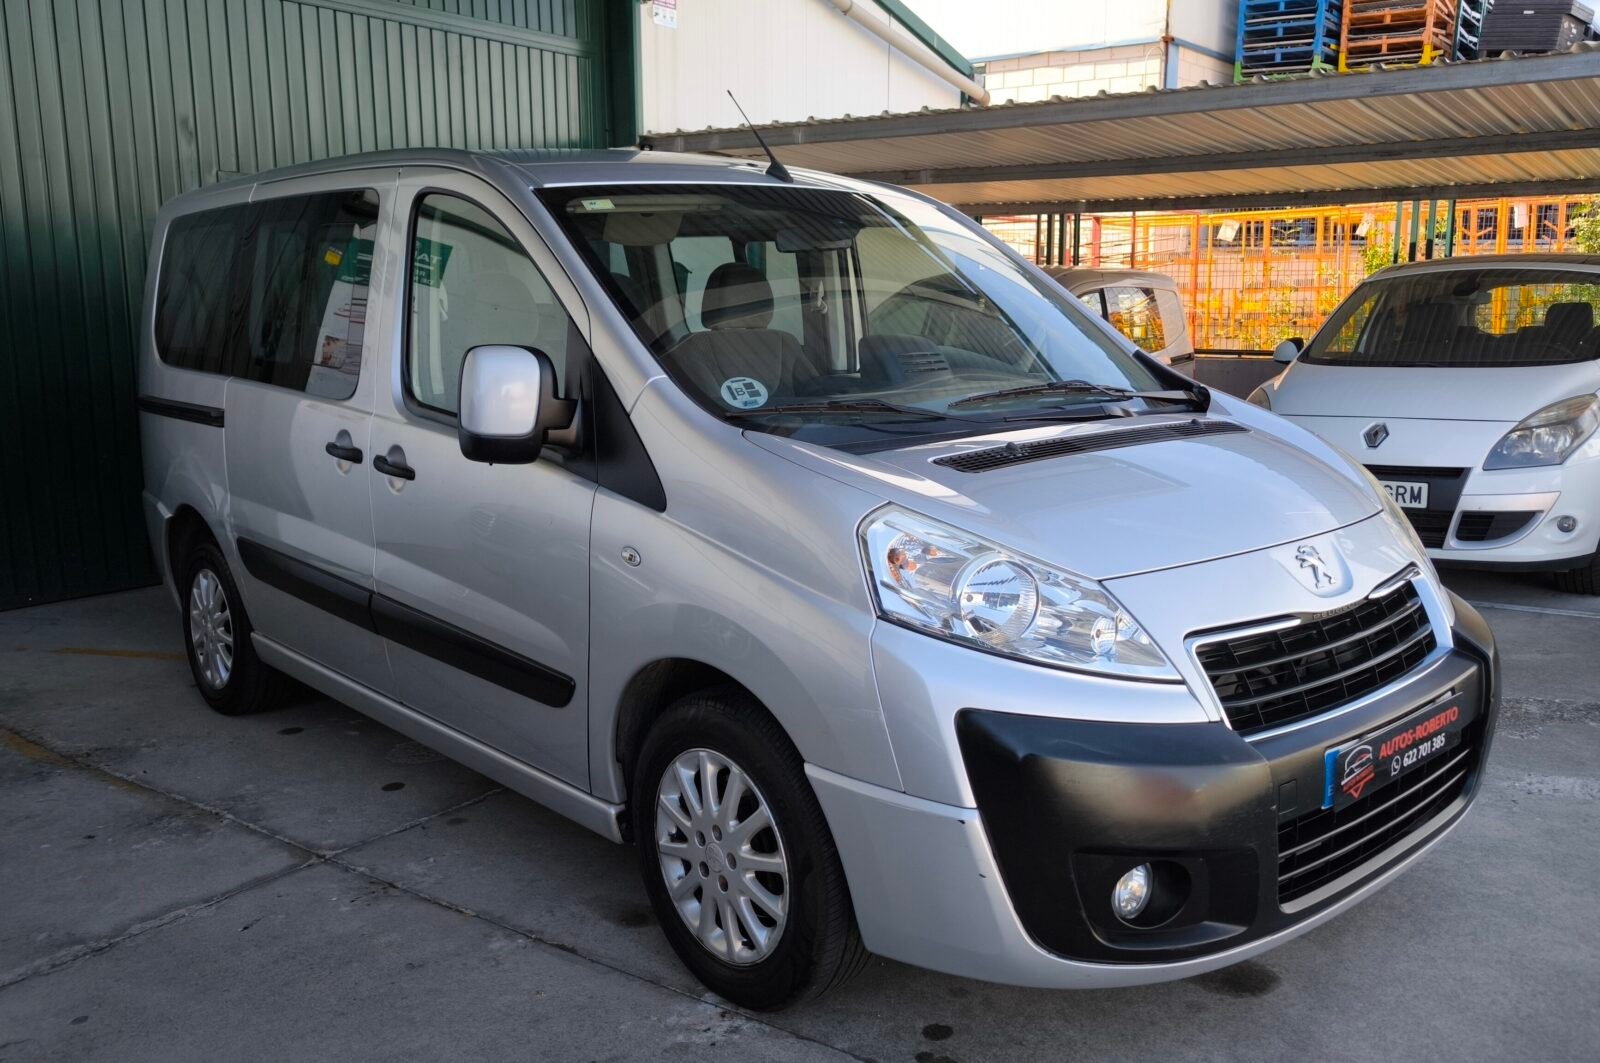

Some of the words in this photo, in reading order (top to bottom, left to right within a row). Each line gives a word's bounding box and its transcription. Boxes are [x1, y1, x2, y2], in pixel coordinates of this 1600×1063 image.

[735, 387, 746, 396] B
[1379, 706, 1458, 760] AUTOS-ROBERTO
[1403, 748, 1418, 767] 622
[1418, 740, 1431, 759] 701
[1432, 732, 1446, 752] 385
